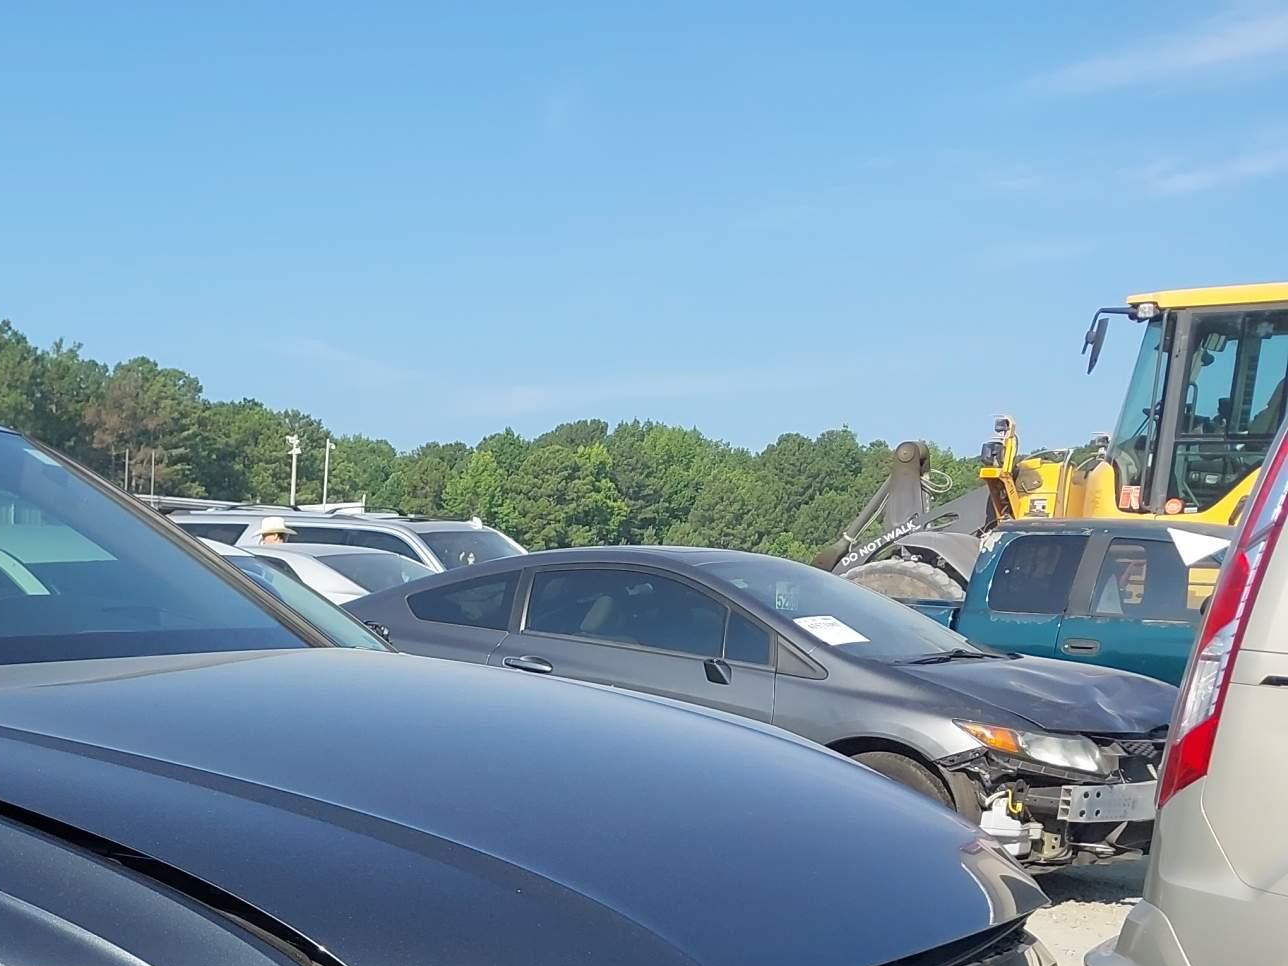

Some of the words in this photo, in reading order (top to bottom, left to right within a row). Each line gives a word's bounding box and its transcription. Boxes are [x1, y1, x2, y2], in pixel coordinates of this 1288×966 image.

[841, 552, 858, 566] DO
[859, 538, 882, 556] NOT
[883, 520, 916, 541] WALK
